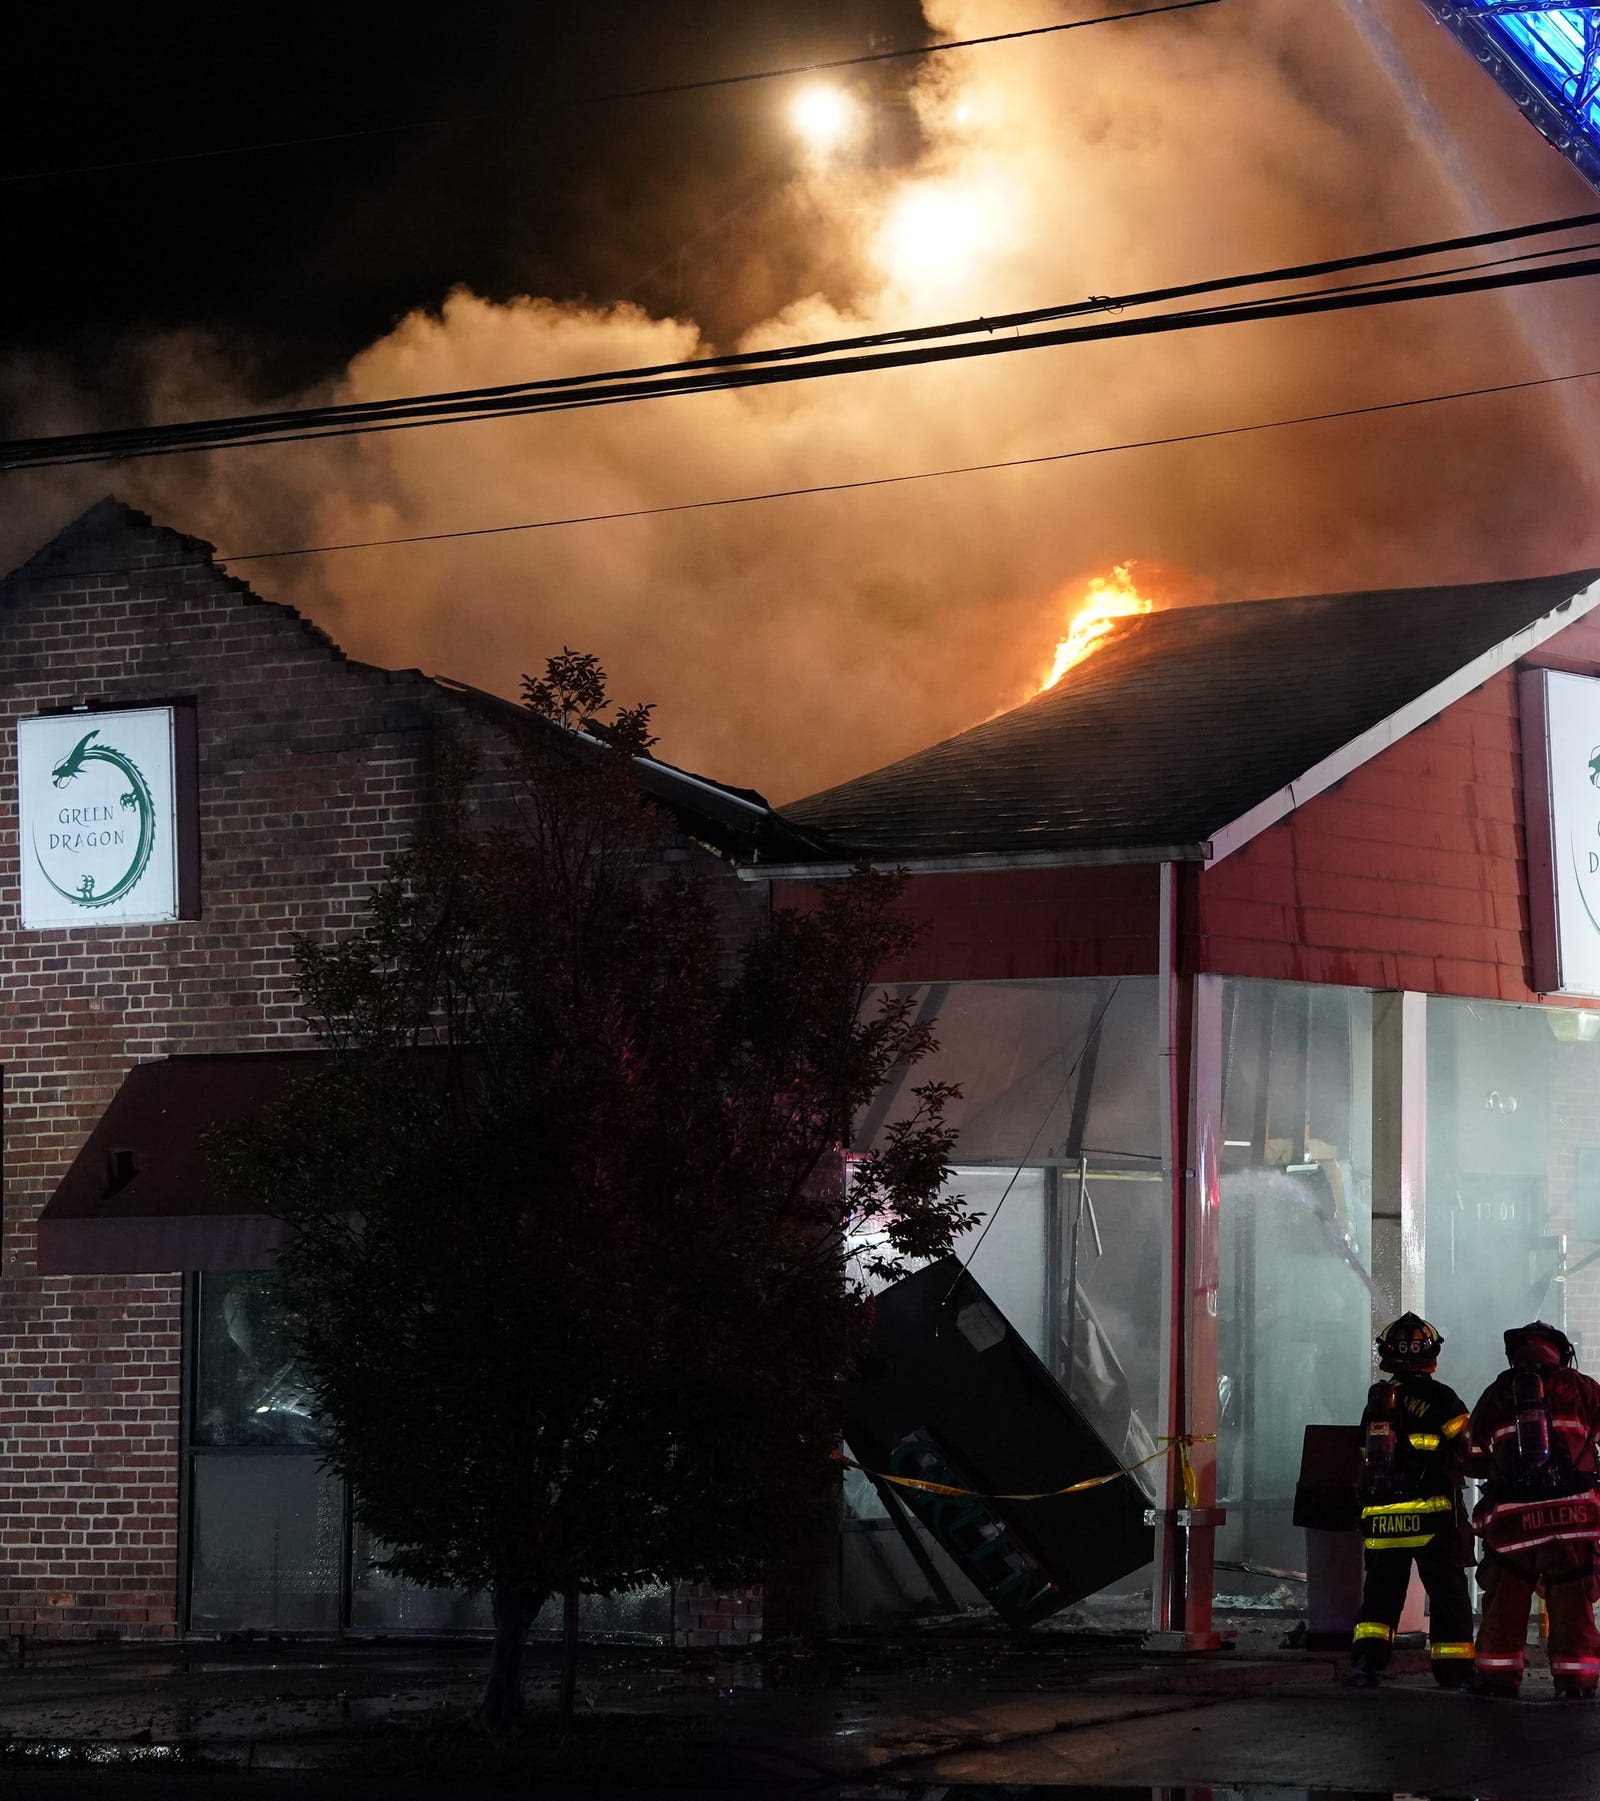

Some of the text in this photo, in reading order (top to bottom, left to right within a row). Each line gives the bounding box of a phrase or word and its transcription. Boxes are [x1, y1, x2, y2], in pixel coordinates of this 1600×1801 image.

[58, 806, 114, 828] GREEN
[49, 830, 125, 854] DRAGON
[1398, 1340, 1421, 1354] 66
[1371, 1514, 1421, 1534] FRANCO
[1521, 1505, 1589, 1532] MULLENS
